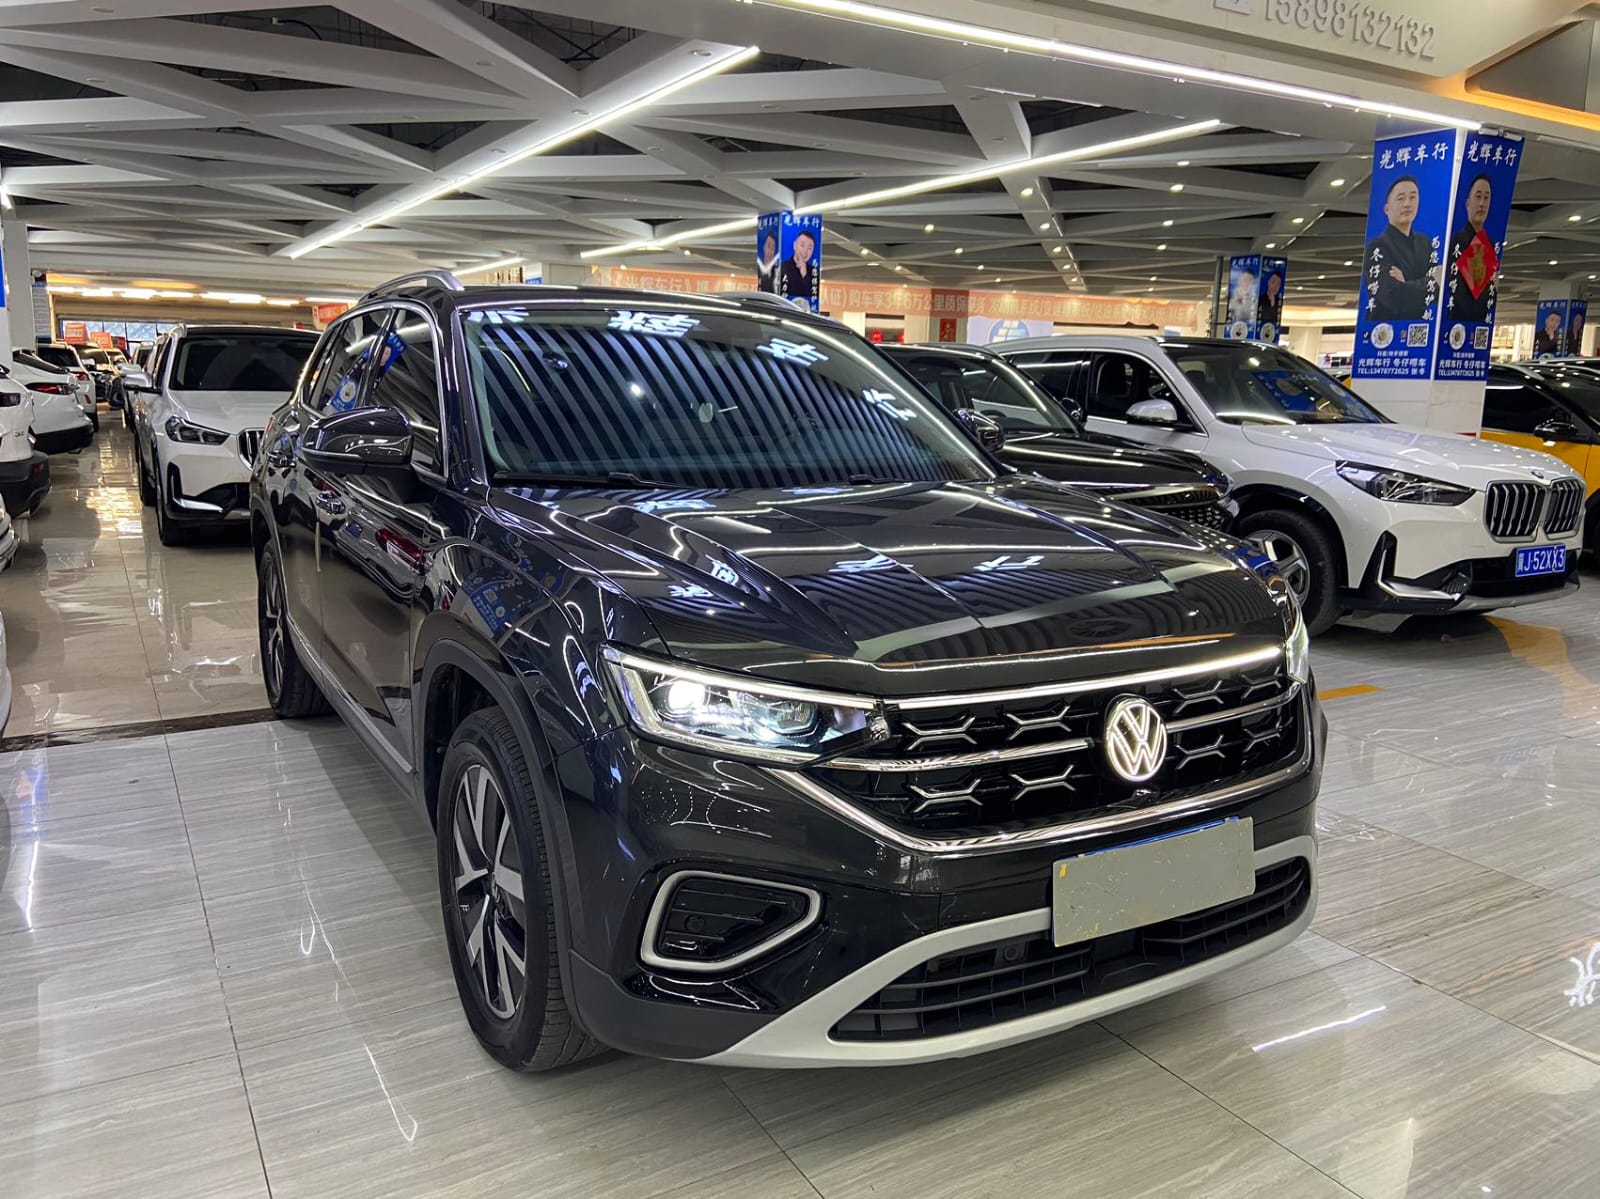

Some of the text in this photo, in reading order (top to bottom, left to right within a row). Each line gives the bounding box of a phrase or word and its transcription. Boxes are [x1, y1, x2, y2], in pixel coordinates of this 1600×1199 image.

[1379, 141, 1449, 169] 光辉车行
[1467, 140, 1517, 167] 光辉车行
